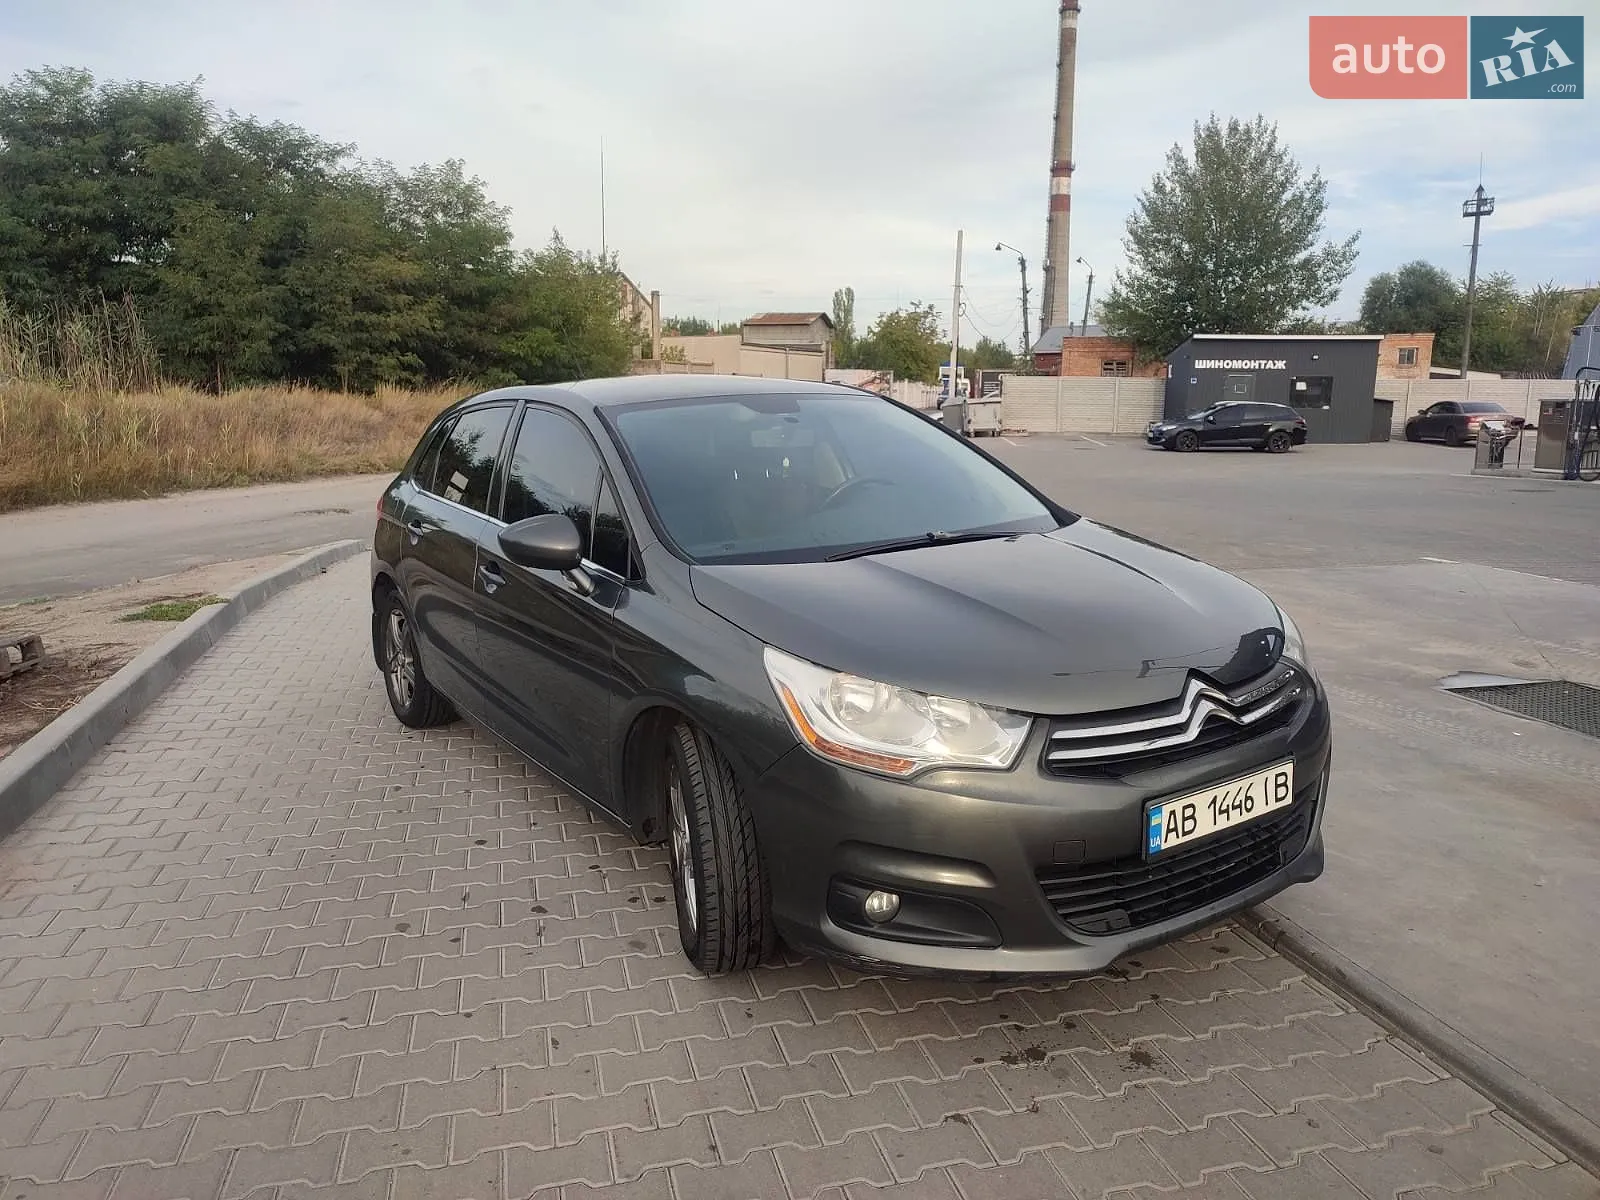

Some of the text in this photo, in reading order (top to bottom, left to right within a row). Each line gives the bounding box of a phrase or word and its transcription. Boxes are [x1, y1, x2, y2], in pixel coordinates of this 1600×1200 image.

[1194, 359, 1286, 369] ШИНОМОНТАЖ
[1164, 771, 1289, 843] AB 1446 IB
[1150, 835, 1161, 848] UA
